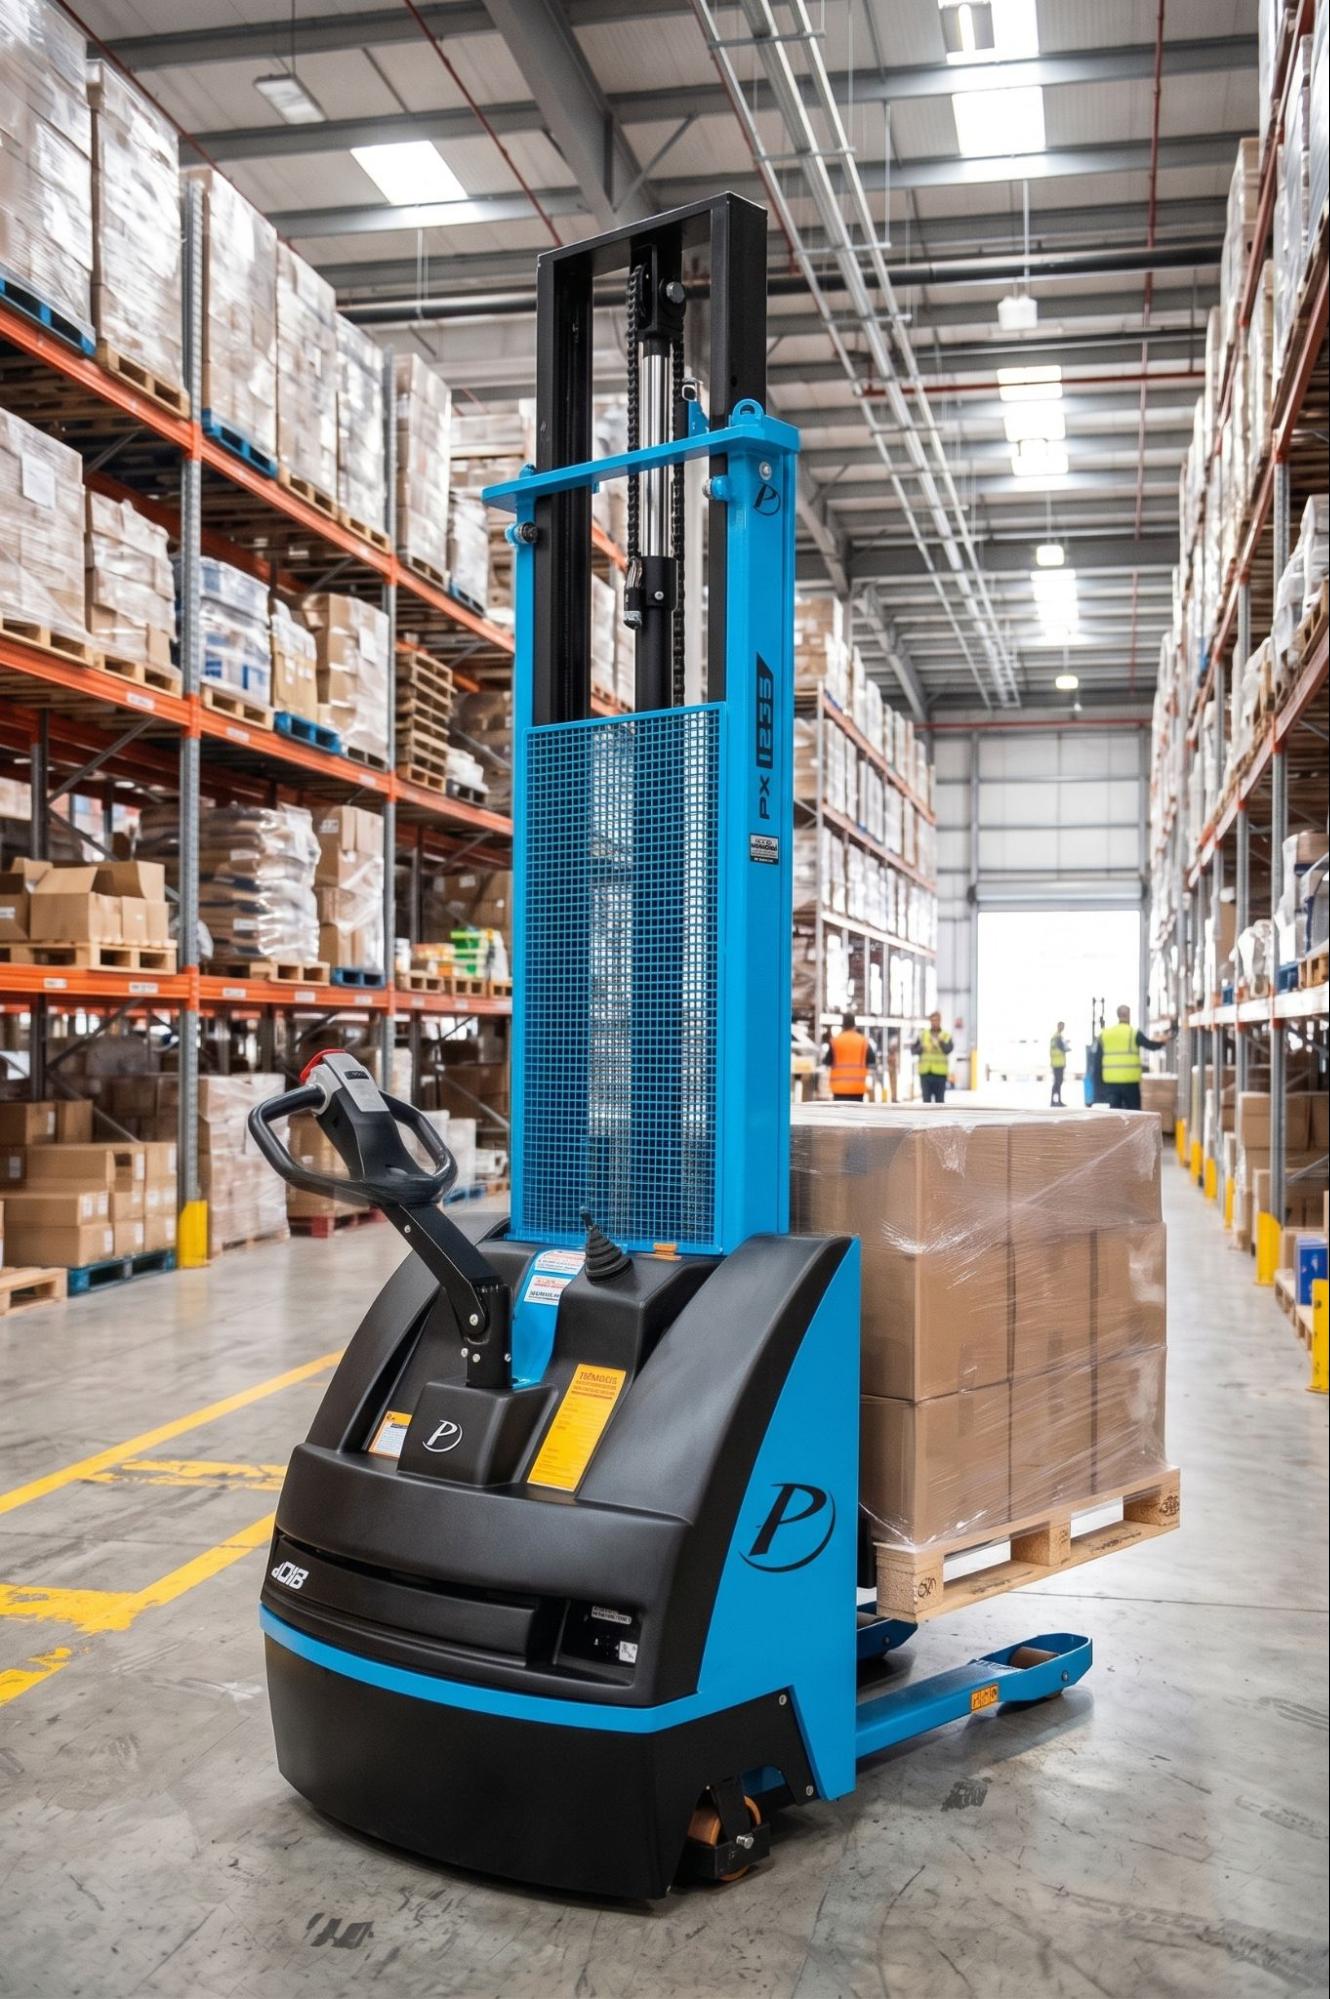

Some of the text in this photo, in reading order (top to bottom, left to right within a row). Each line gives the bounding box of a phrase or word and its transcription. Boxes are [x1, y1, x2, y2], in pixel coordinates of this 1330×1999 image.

[758, 774, 772, 820] PX
[427, 1419, 458, 1446] P
[747, 1482, 828, 1557] P
